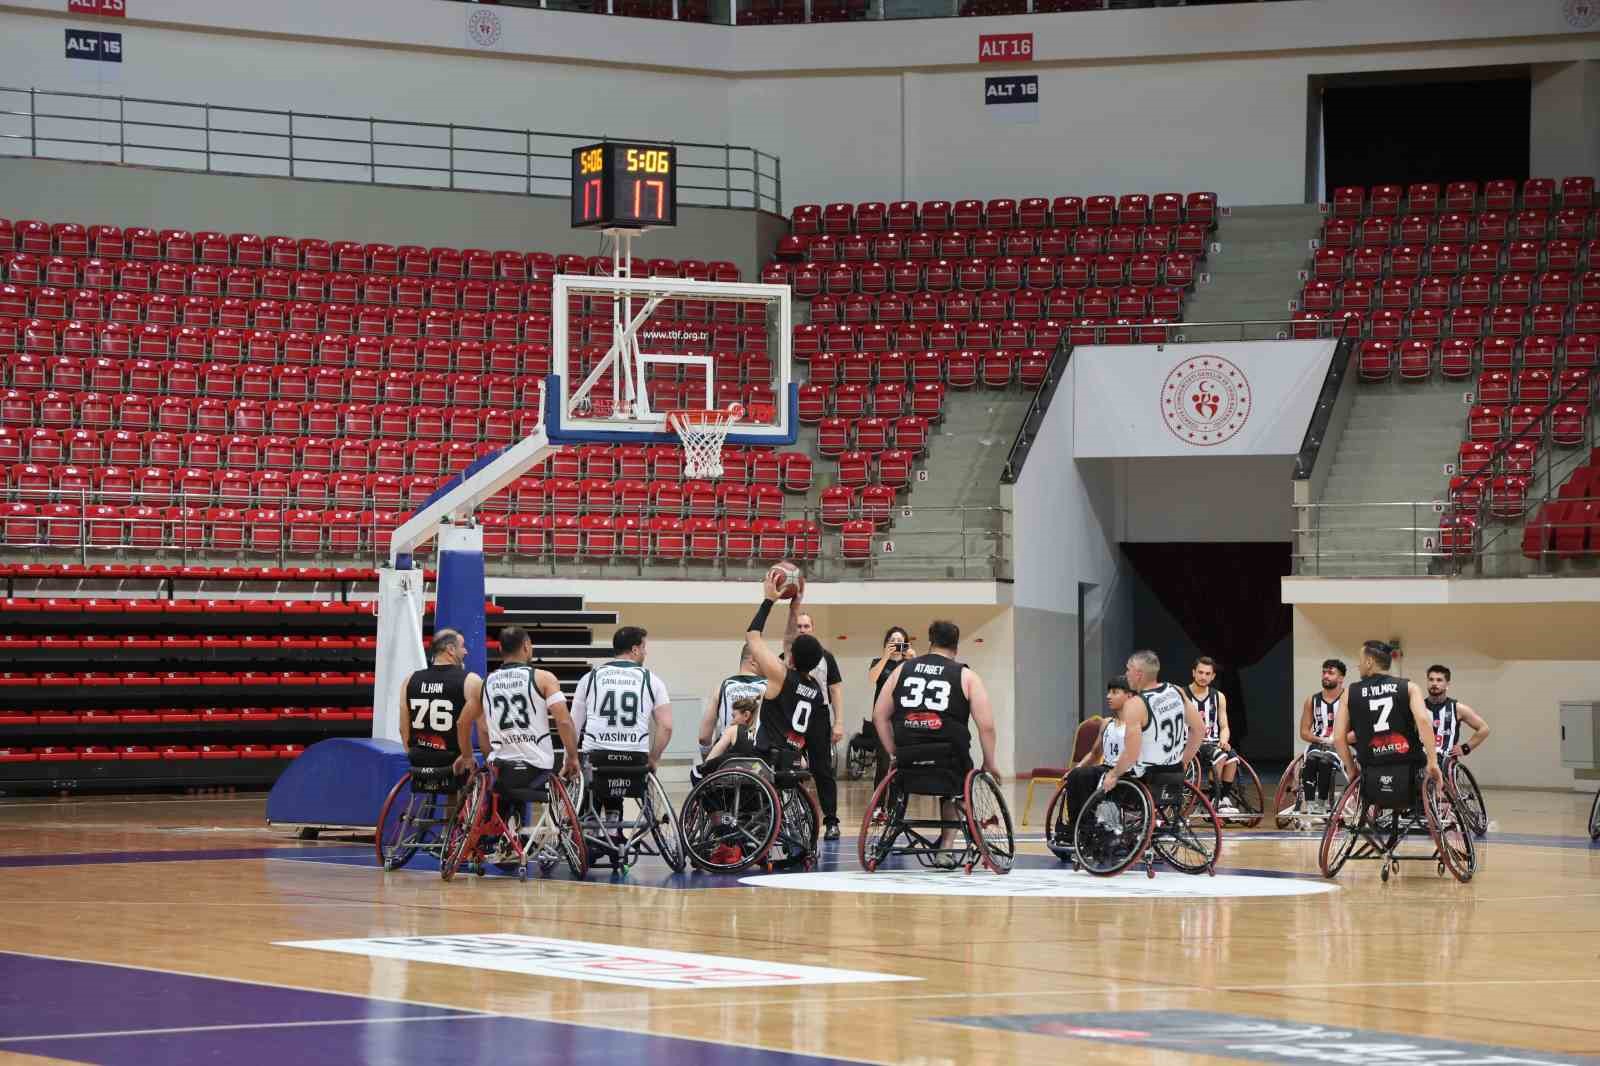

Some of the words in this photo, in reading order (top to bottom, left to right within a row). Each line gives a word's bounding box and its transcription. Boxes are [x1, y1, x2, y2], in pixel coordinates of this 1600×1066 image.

[67, 38, 98, 51] ALT
[103, 40, 121, 53] 15
[981, 40, 1008, 56] ALT
[1011, 39, 1031, 55] 16
[986, 84, 1015, 96] ALT
[581, 148, 603, 174] 5:06
[627, 149, 669, 173] 5:06
[584, 179, 602, 219] 17
[634, 180, 664, 219] 17
[643, 330, 709, 341] www.tbf.org.tr
[914, 663, 945, 675] ATABEY
[420, 682, 444, 694] İLHAN
[901, 676, 951, 711] 33
[409, 698, 454, 732] 76
[493, 693, 531, 730] 23
[600, 690, 639, 727] 49
[792, 700, 812, 733] 0
[1369, 696, 1394, 732] 7
[1161, 713, 1184, 753] 30
[1110, 743, 1119, 757] 14
